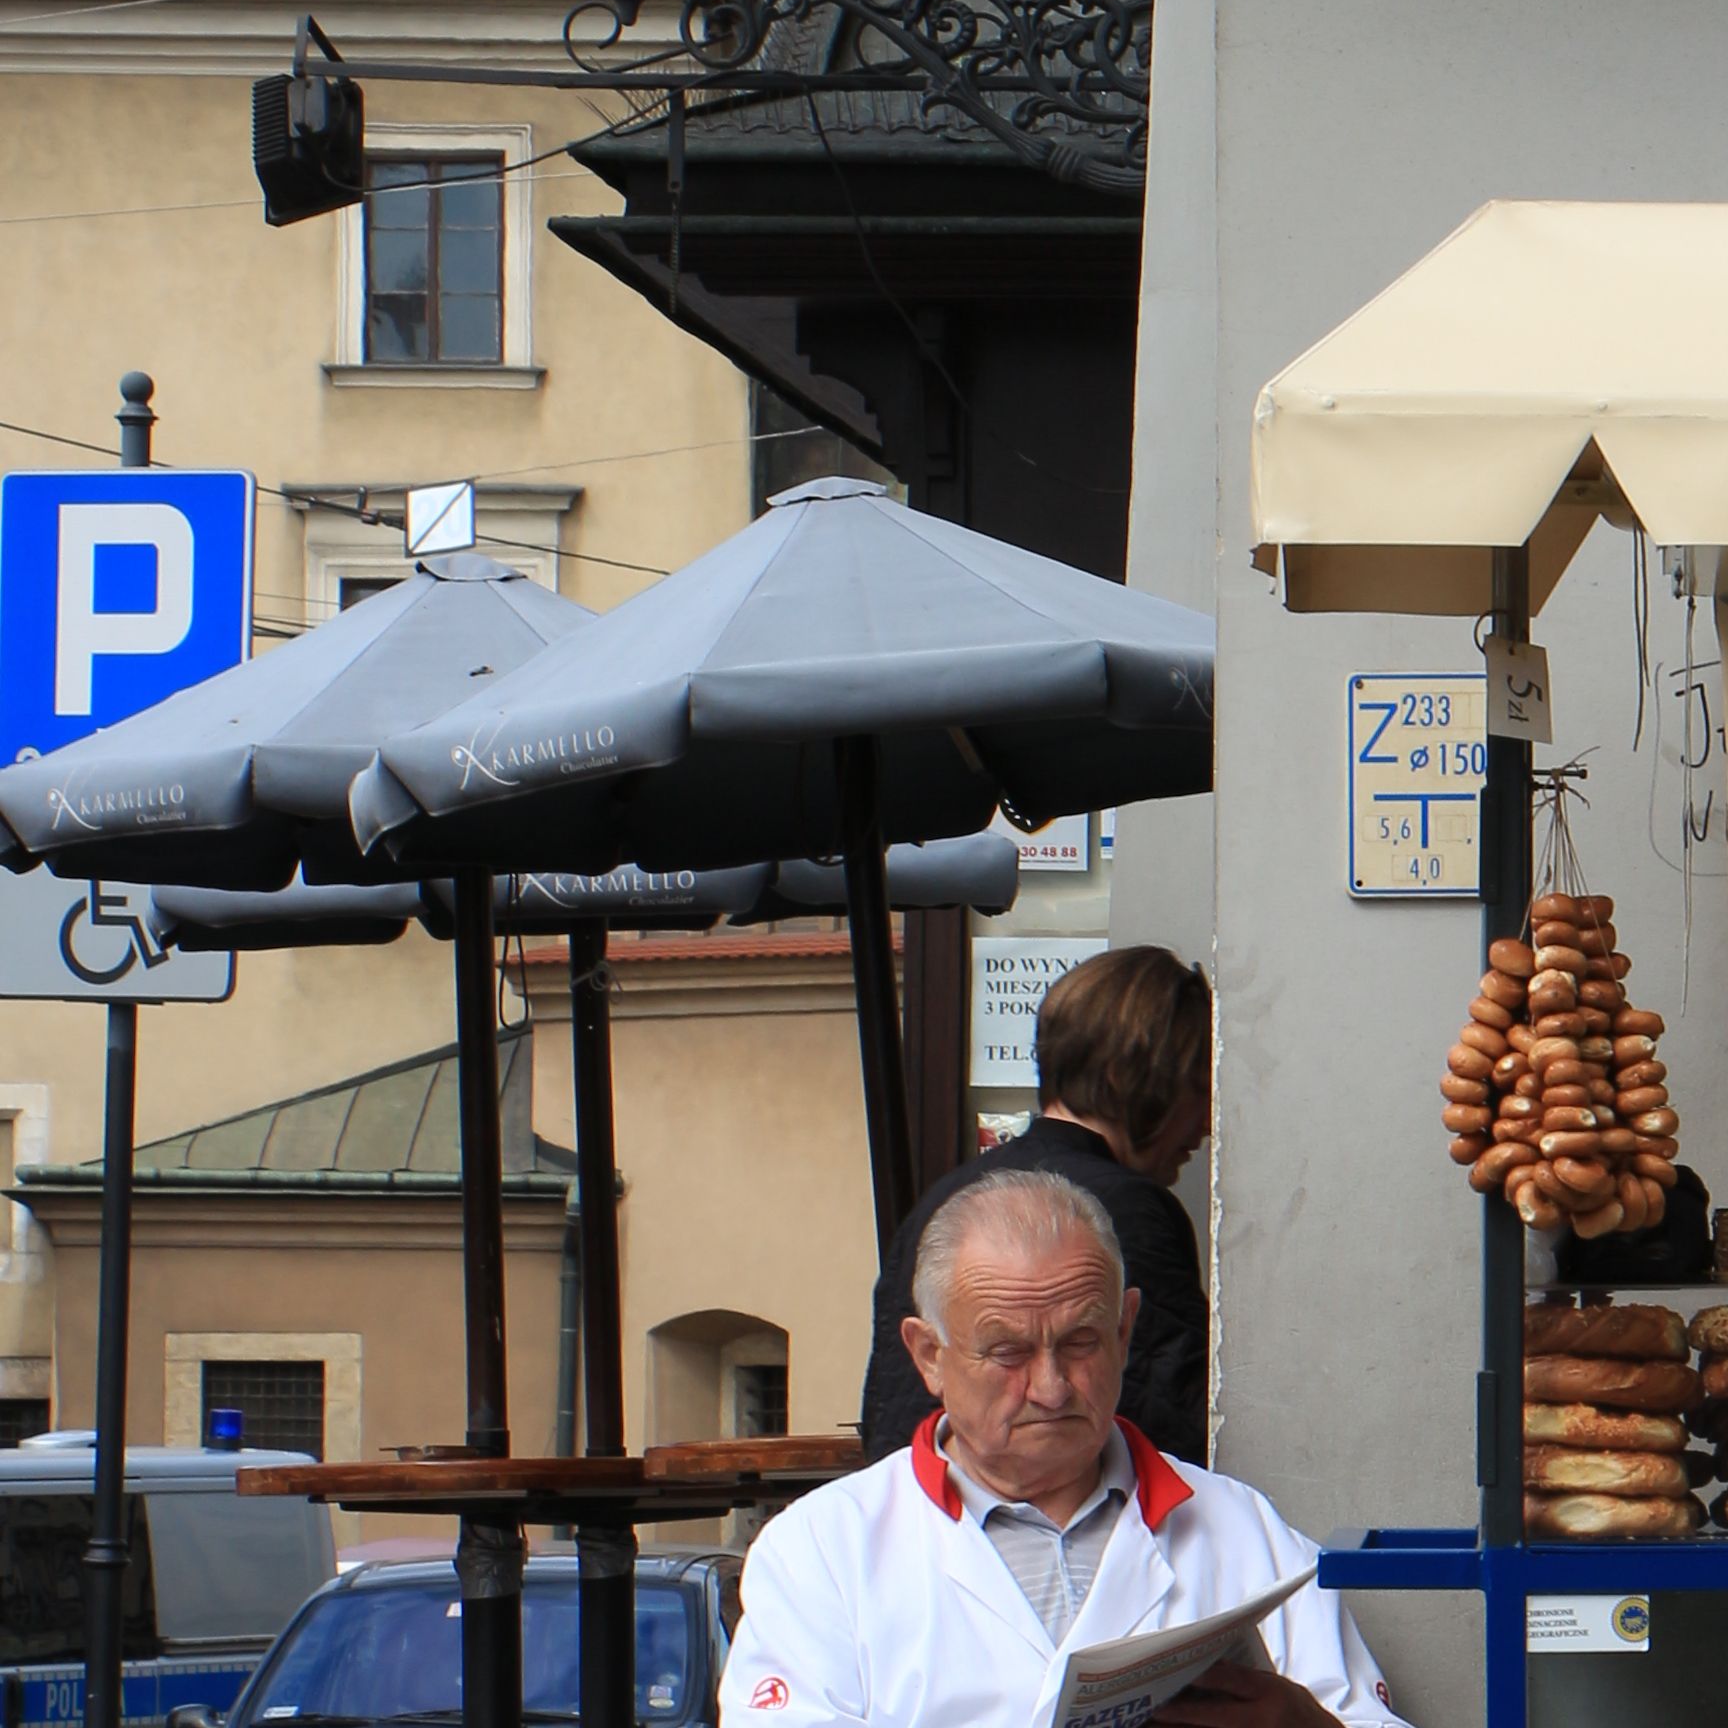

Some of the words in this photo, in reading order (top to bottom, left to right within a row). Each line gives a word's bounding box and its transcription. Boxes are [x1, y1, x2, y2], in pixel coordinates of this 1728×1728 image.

[55, 503, 195, 716] P
[1402, 694, 1451, 727] 233
[1359, 702, 1398, 763] Z
[492, 724, 615, 772] KARMELLO
[1439, 743, 1487, 775] 150
[554, 870, 696, 894] KARMELLO
[985, 957, 1015, 974] DO
[1021, 957, 1081, 974] WYN
[985, 980, 1050, 995] MIESZ
[999, 1000, 1038, 1016] POK
[985, 1044, 1037, 1062] TEL.
